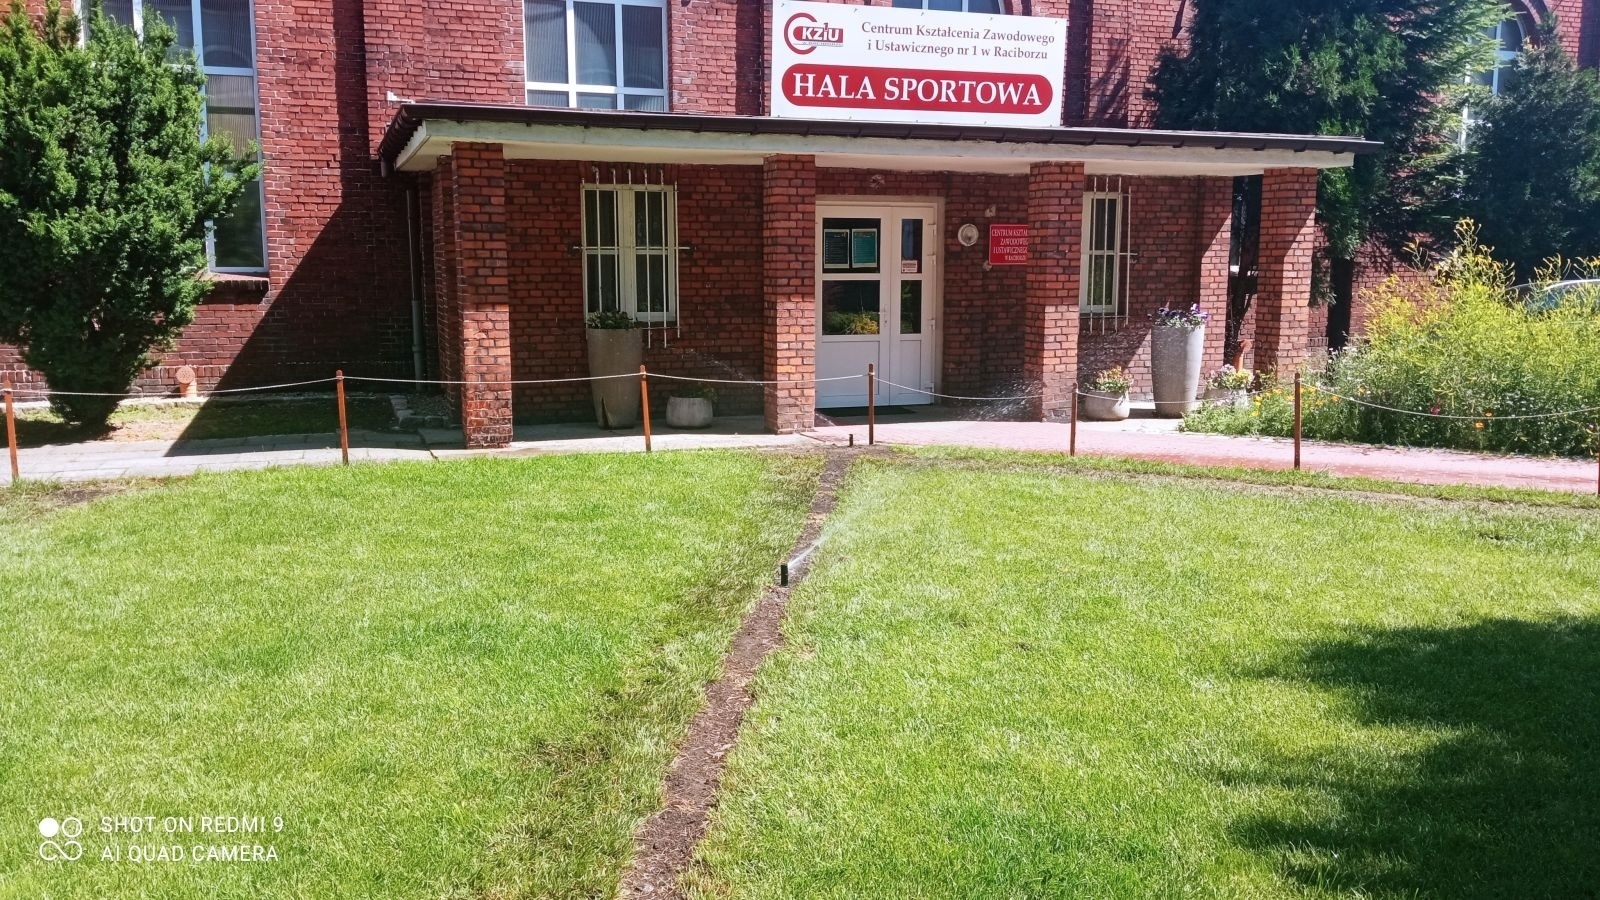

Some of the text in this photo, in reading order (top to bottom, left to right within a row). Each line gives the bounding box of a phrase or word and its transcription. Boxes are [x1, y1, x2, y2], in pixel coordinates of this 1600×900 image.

[861, 21, 1055, 47] Centrum Kształcenia Zawodowego
[867, 39, 1048, 59] i Ustawicznego nr 1 w Raciborzu
[792, 72, 1043, 107] HALA SPORTOWA
[991, 228, 1013, 237] CENTRUM
